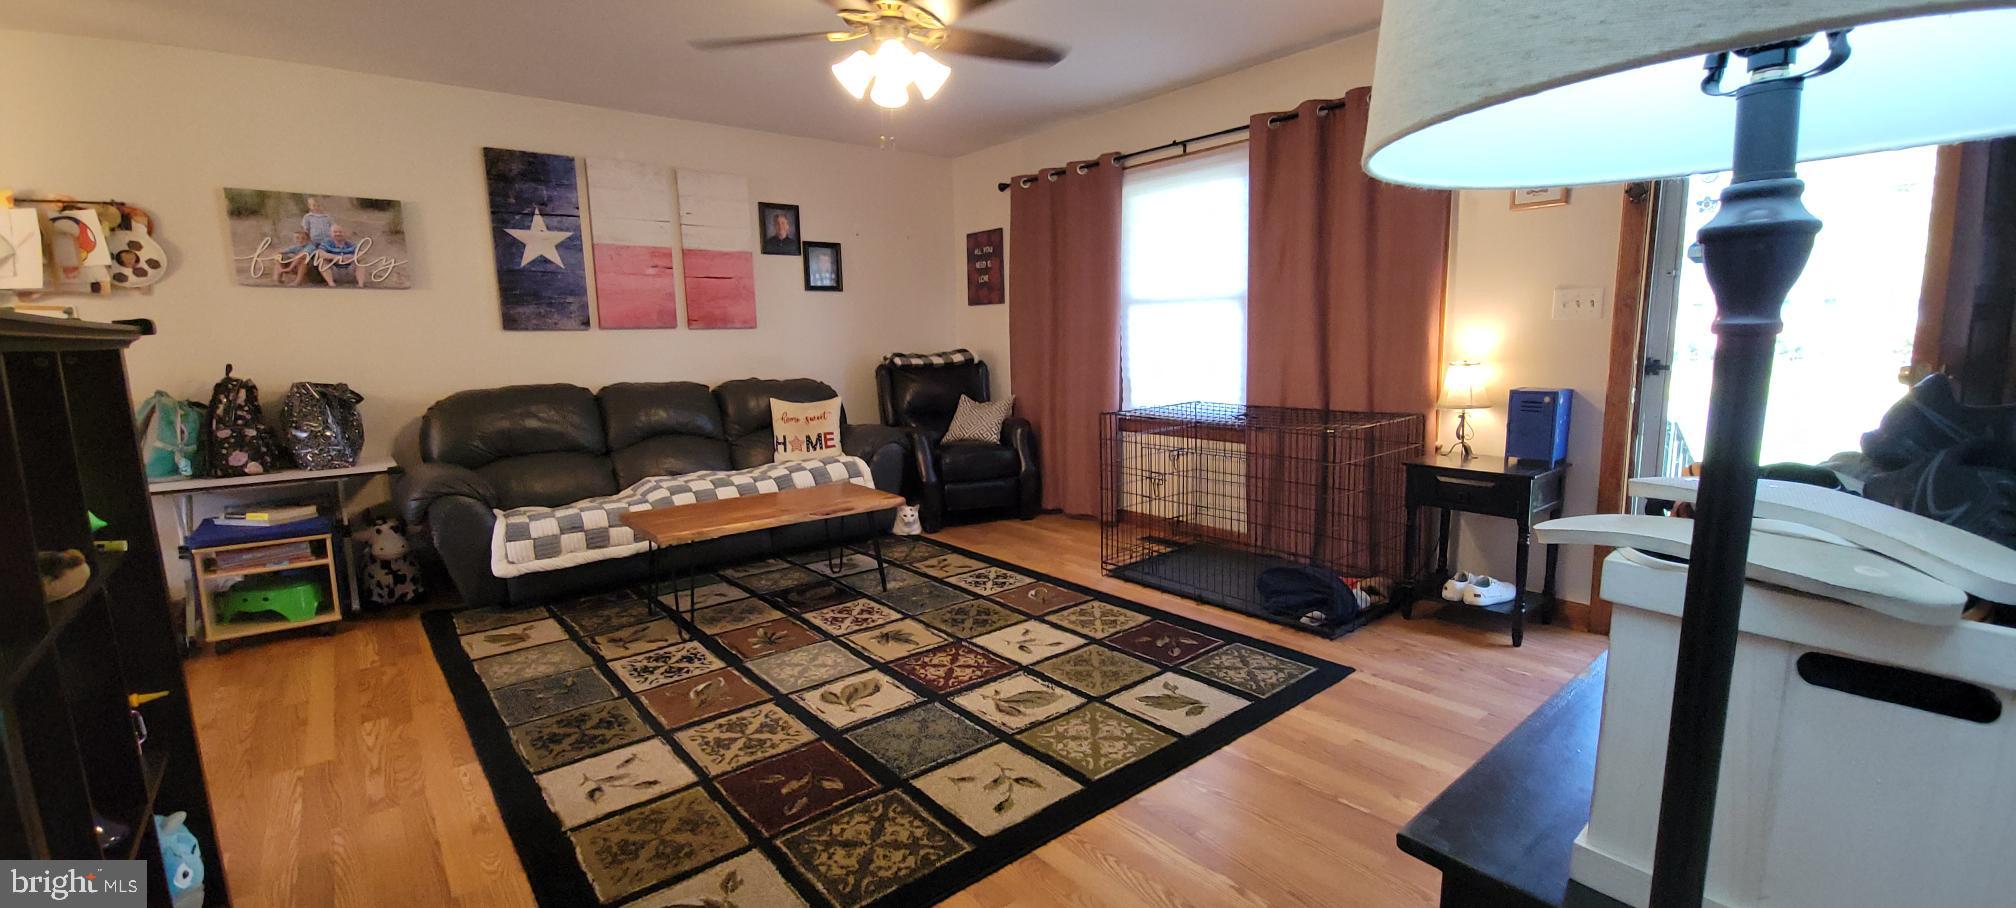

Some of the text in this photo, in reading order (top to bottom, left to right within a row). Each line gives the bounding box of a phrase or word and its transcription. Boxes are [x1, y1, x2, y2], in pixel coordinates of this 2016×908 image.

[983, 245, 993, 254] YOU
[234, 236, 409, 282] family
[975, 261, 987, 269] NEED
[978, 275, 989, 283] LOVE
[781, 411, 832, 424] home sweet
